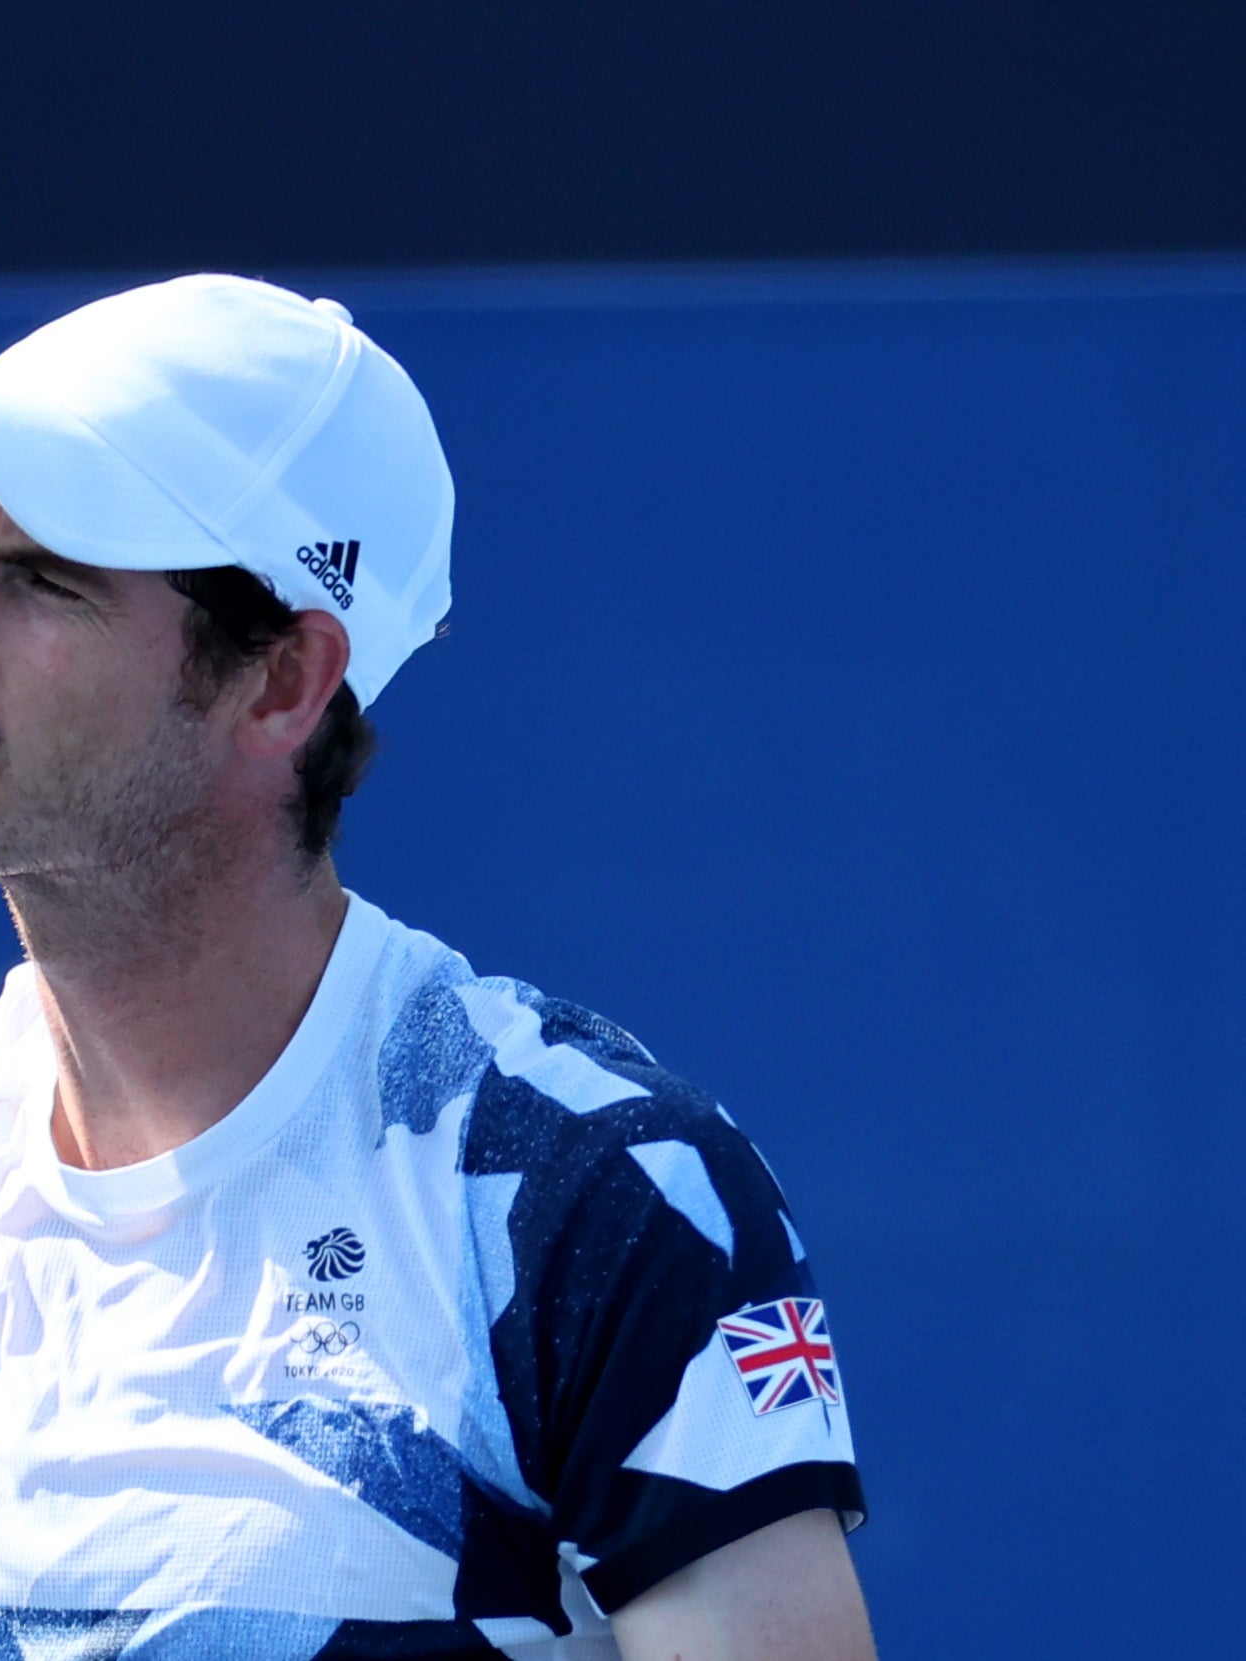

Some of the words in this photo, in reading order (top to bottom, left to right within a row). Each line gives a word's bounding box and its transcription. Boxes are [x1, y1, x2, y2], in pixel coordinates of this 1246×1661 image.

[296, 545, 354, 611] adidas
[286, 1291, 336, 1312] TEAM
[340, 1292, 365, 1312] GB
